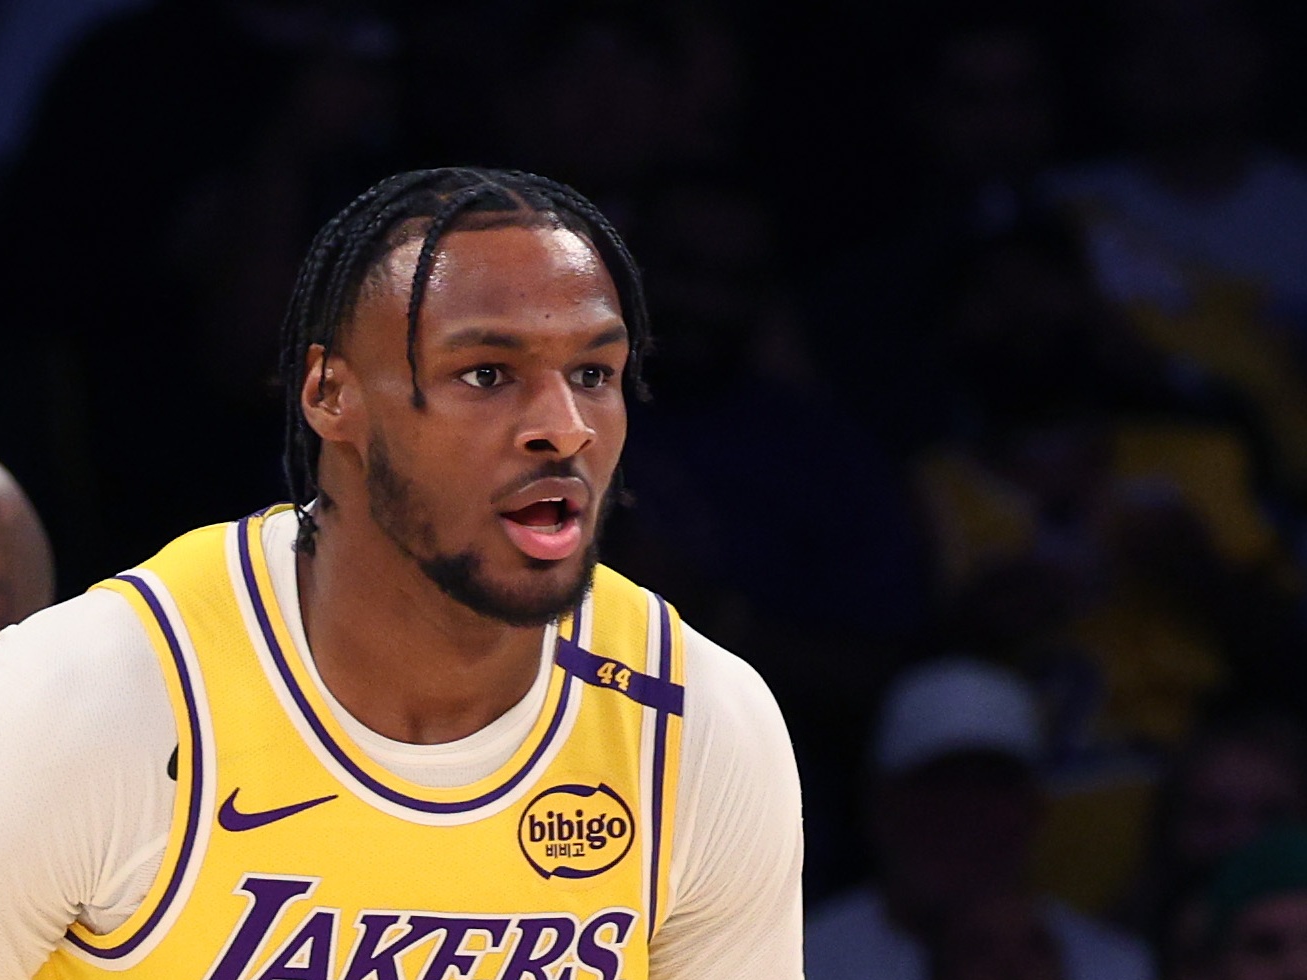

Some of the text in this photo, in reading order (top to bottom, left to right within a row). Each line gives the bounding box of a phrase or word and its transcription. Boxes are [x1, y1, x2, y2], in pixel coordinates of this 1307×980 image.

[596, 661, 632, 692] 44
[528, 809, 627, 850] bibigo
[545, 843, 586, 859] 비비고
